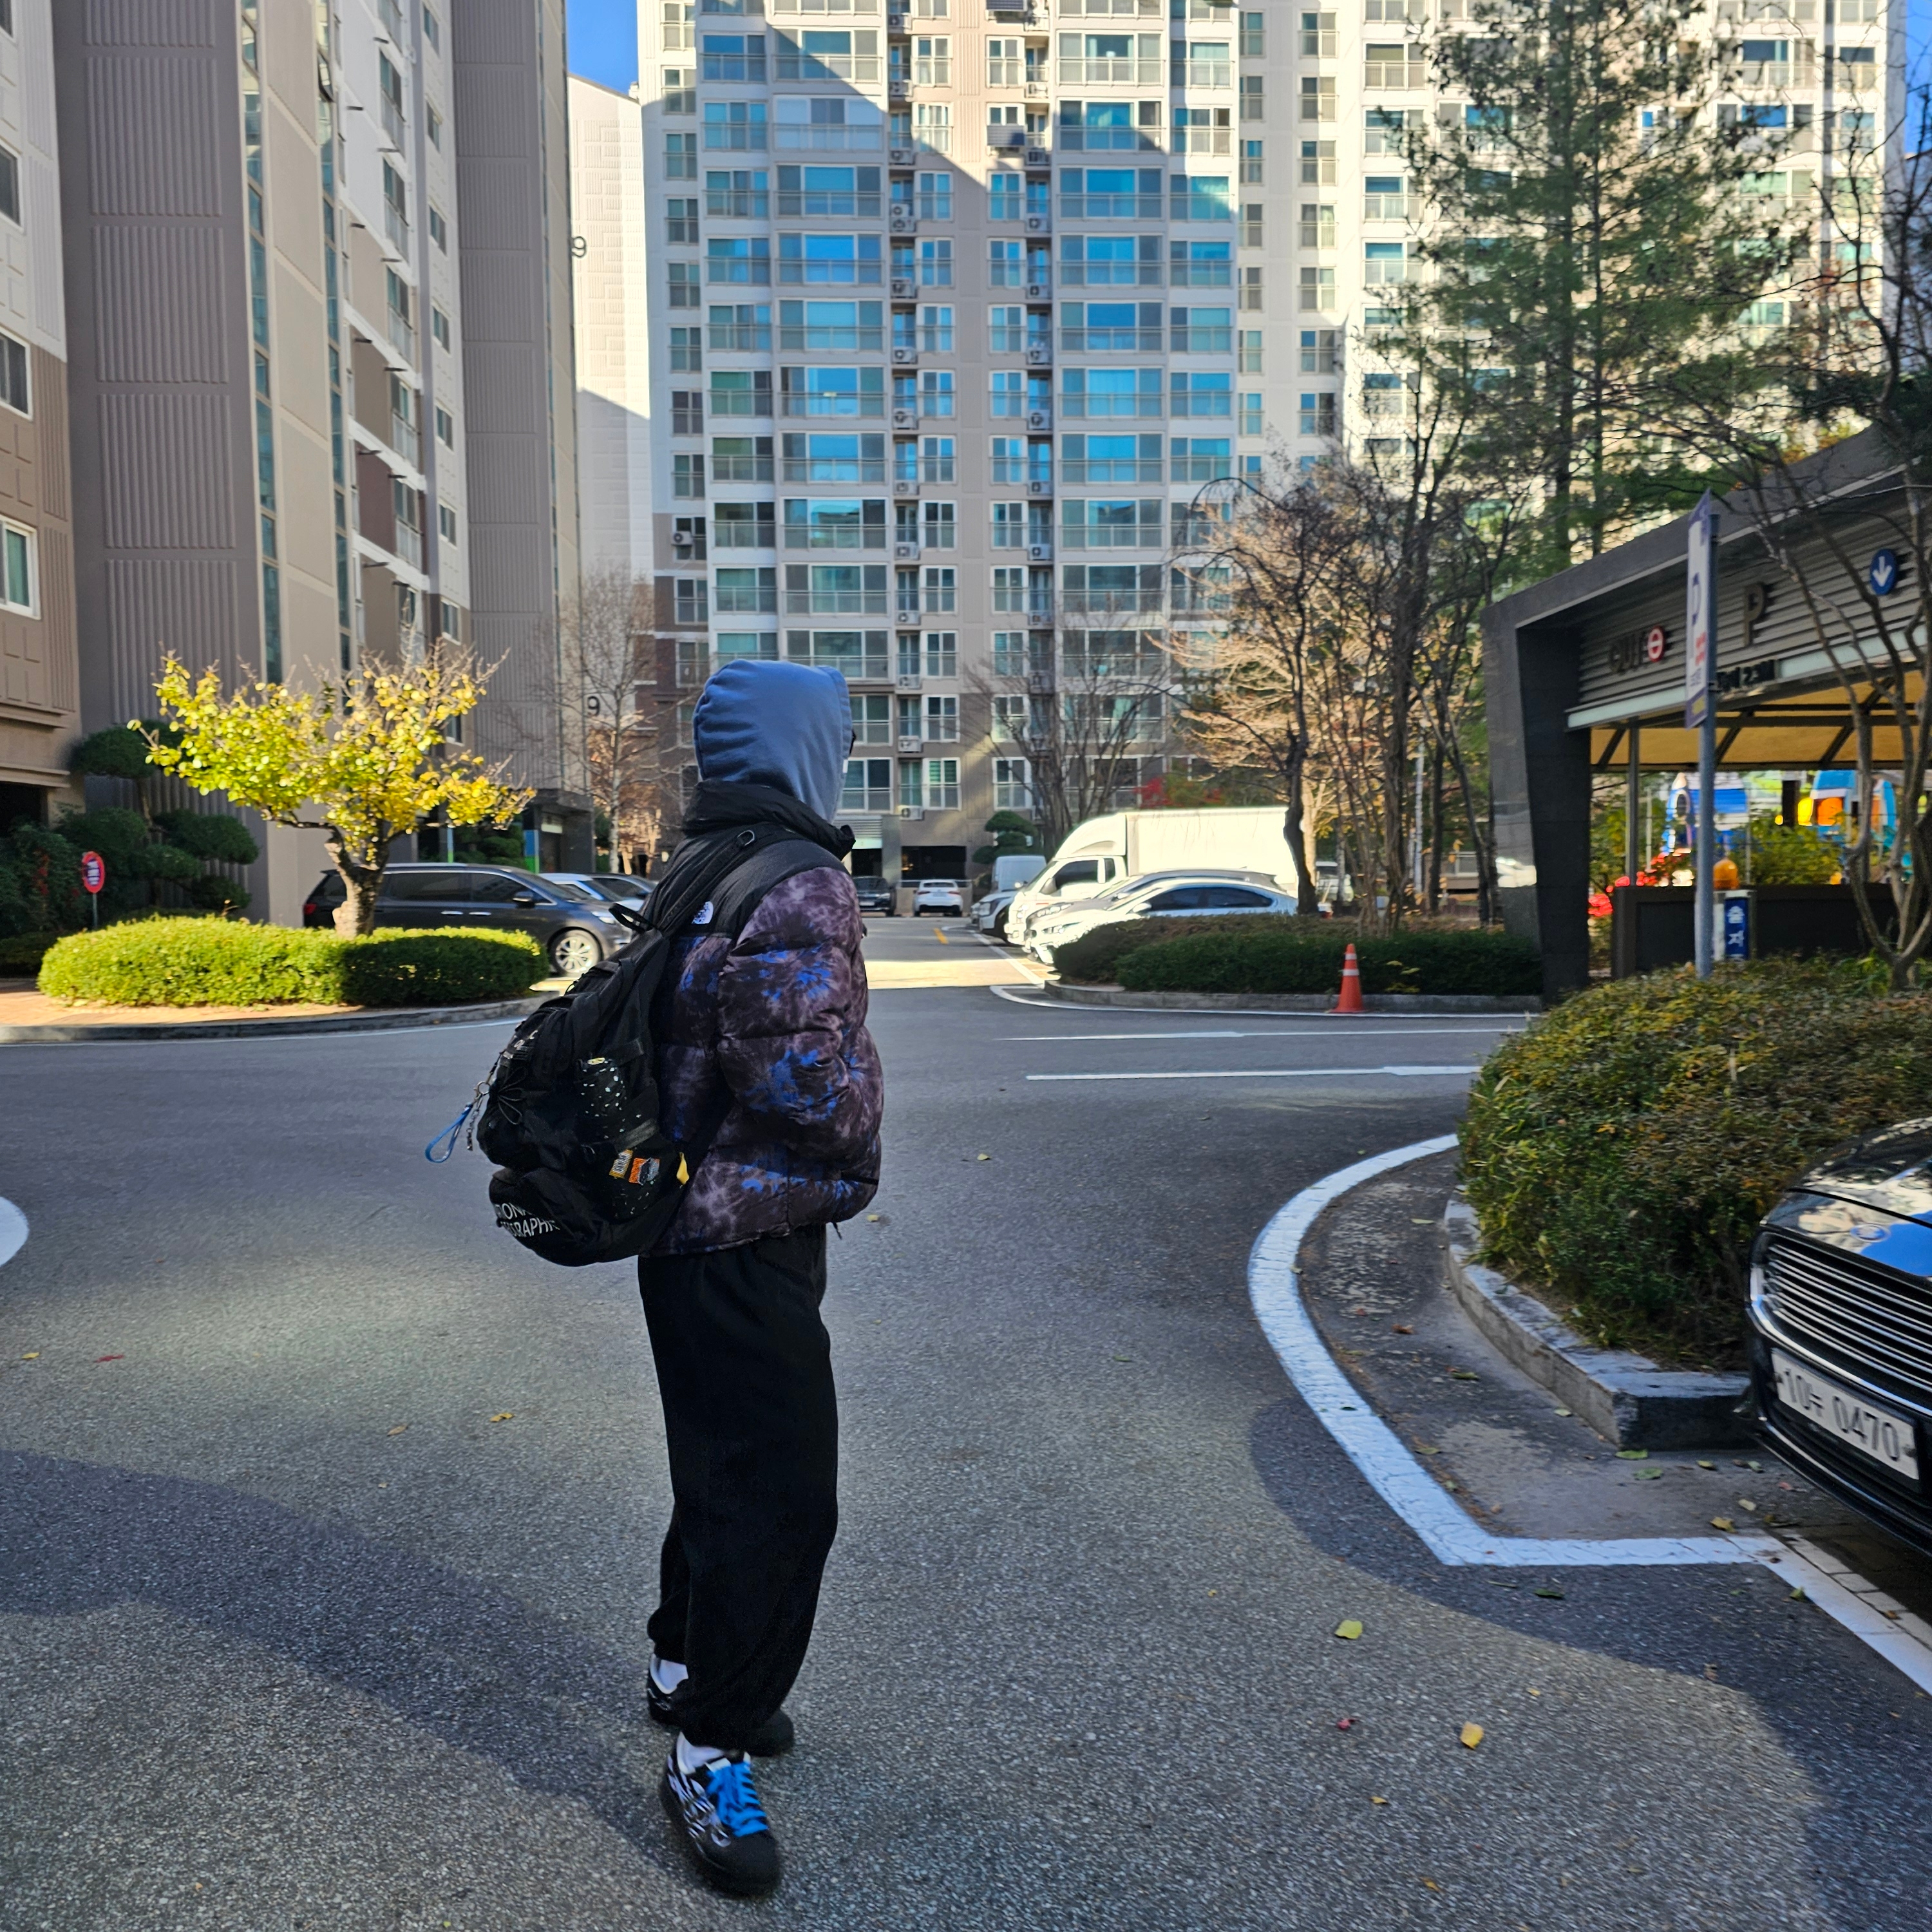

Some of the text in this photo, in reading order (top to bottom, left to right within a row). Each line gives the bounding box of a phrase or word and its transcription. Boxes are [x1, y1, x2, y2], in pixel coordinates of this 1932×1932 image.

[1743, 581, 1765, 647] P
[587, 696, 600, 717] 9
[1833, 1396, 1900, 1461] 0470
